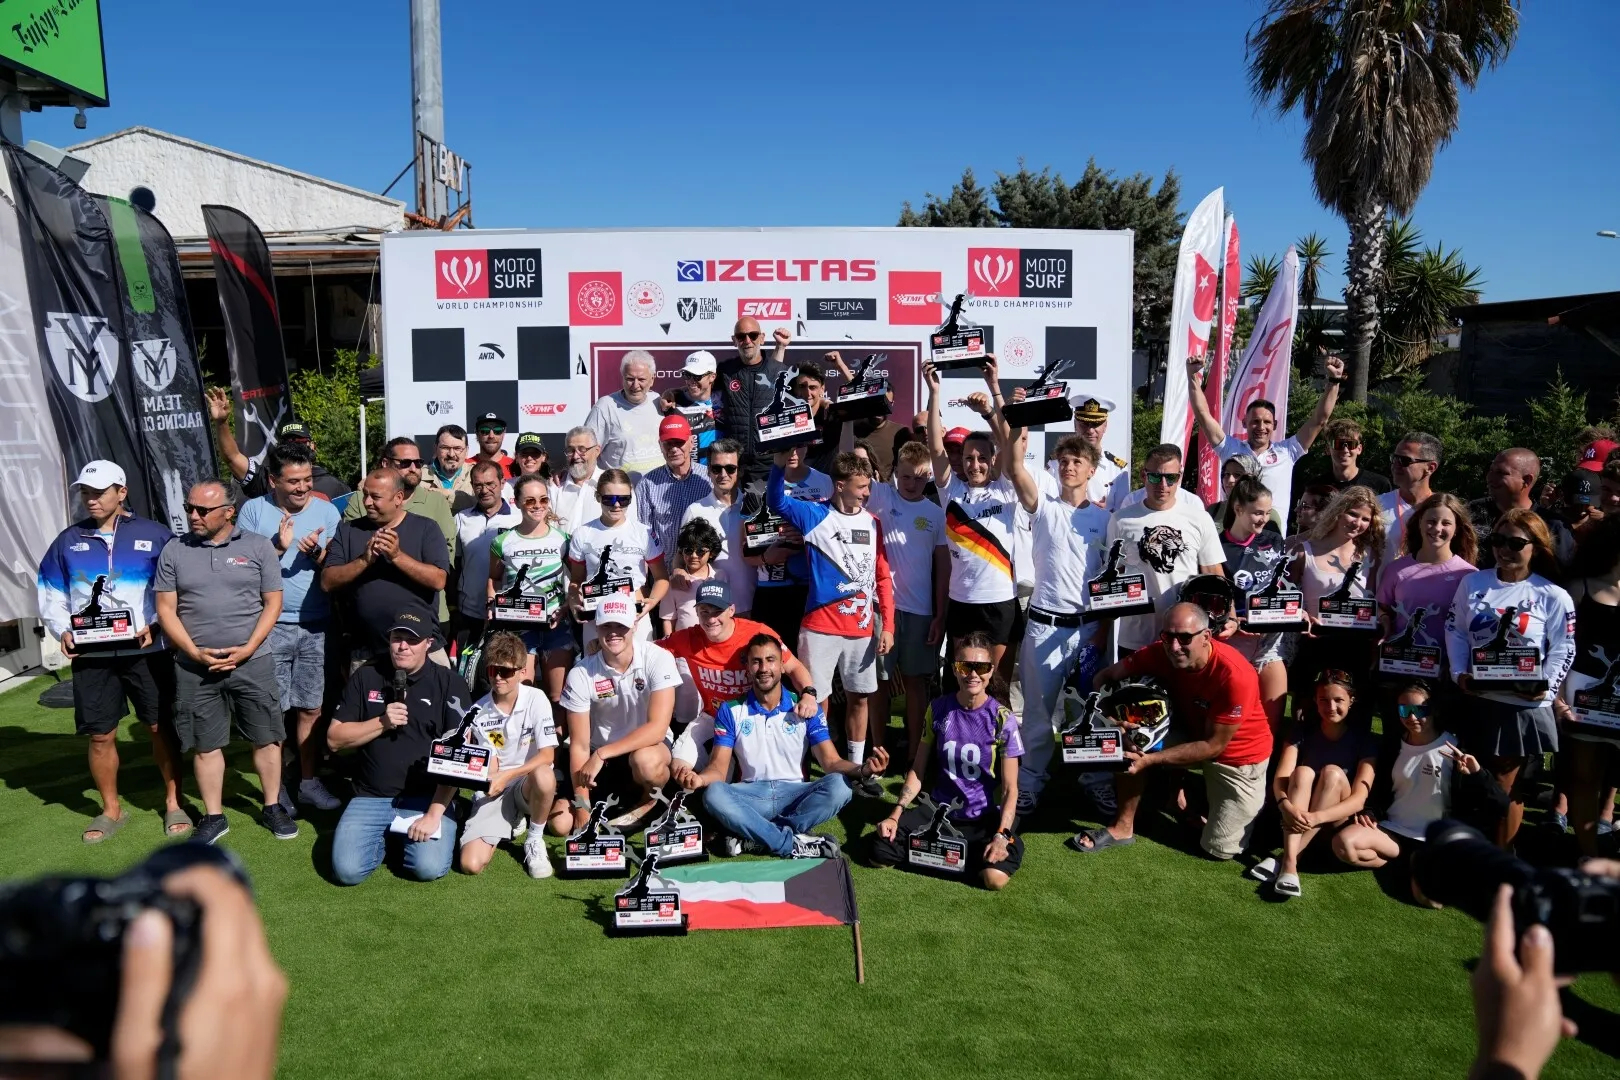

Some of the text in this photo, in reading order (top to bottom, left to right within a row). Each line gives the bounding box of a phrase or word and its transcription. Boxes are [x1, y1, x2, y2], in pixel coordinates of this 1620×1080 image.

[12, 8, 59, 55] Enjoy
[440, 143, 465, 191] BAY
[495, 258, 535, 272] MOTO
[706, 260, 876, 281] IZELTAS
[1026, 258, 1066, 273] MOTO
[495, 274, 535, 288] SURF
[1025, 274, 1066, 288] SURF
[473, 301, 542, 309] CHAMPIONSHIP
[742, 302, 787, 317] SKIL
[819, 301, 864, 311] SIFUNA
[478, 352, 495, 360] ANTA
[654, 370, 682, 378] OTO
[510, 548, 558, 557] JORDAK
[701, 585, 723, 593] HUSKI
[604, 600, 627, 610] HUSKI
[1520, 659, 1533, 667] 1ST
[698, 666, 747, 685] HUSK
[943, 740, 982, 781] 18
[660, 904, 674, 912] 2ND
